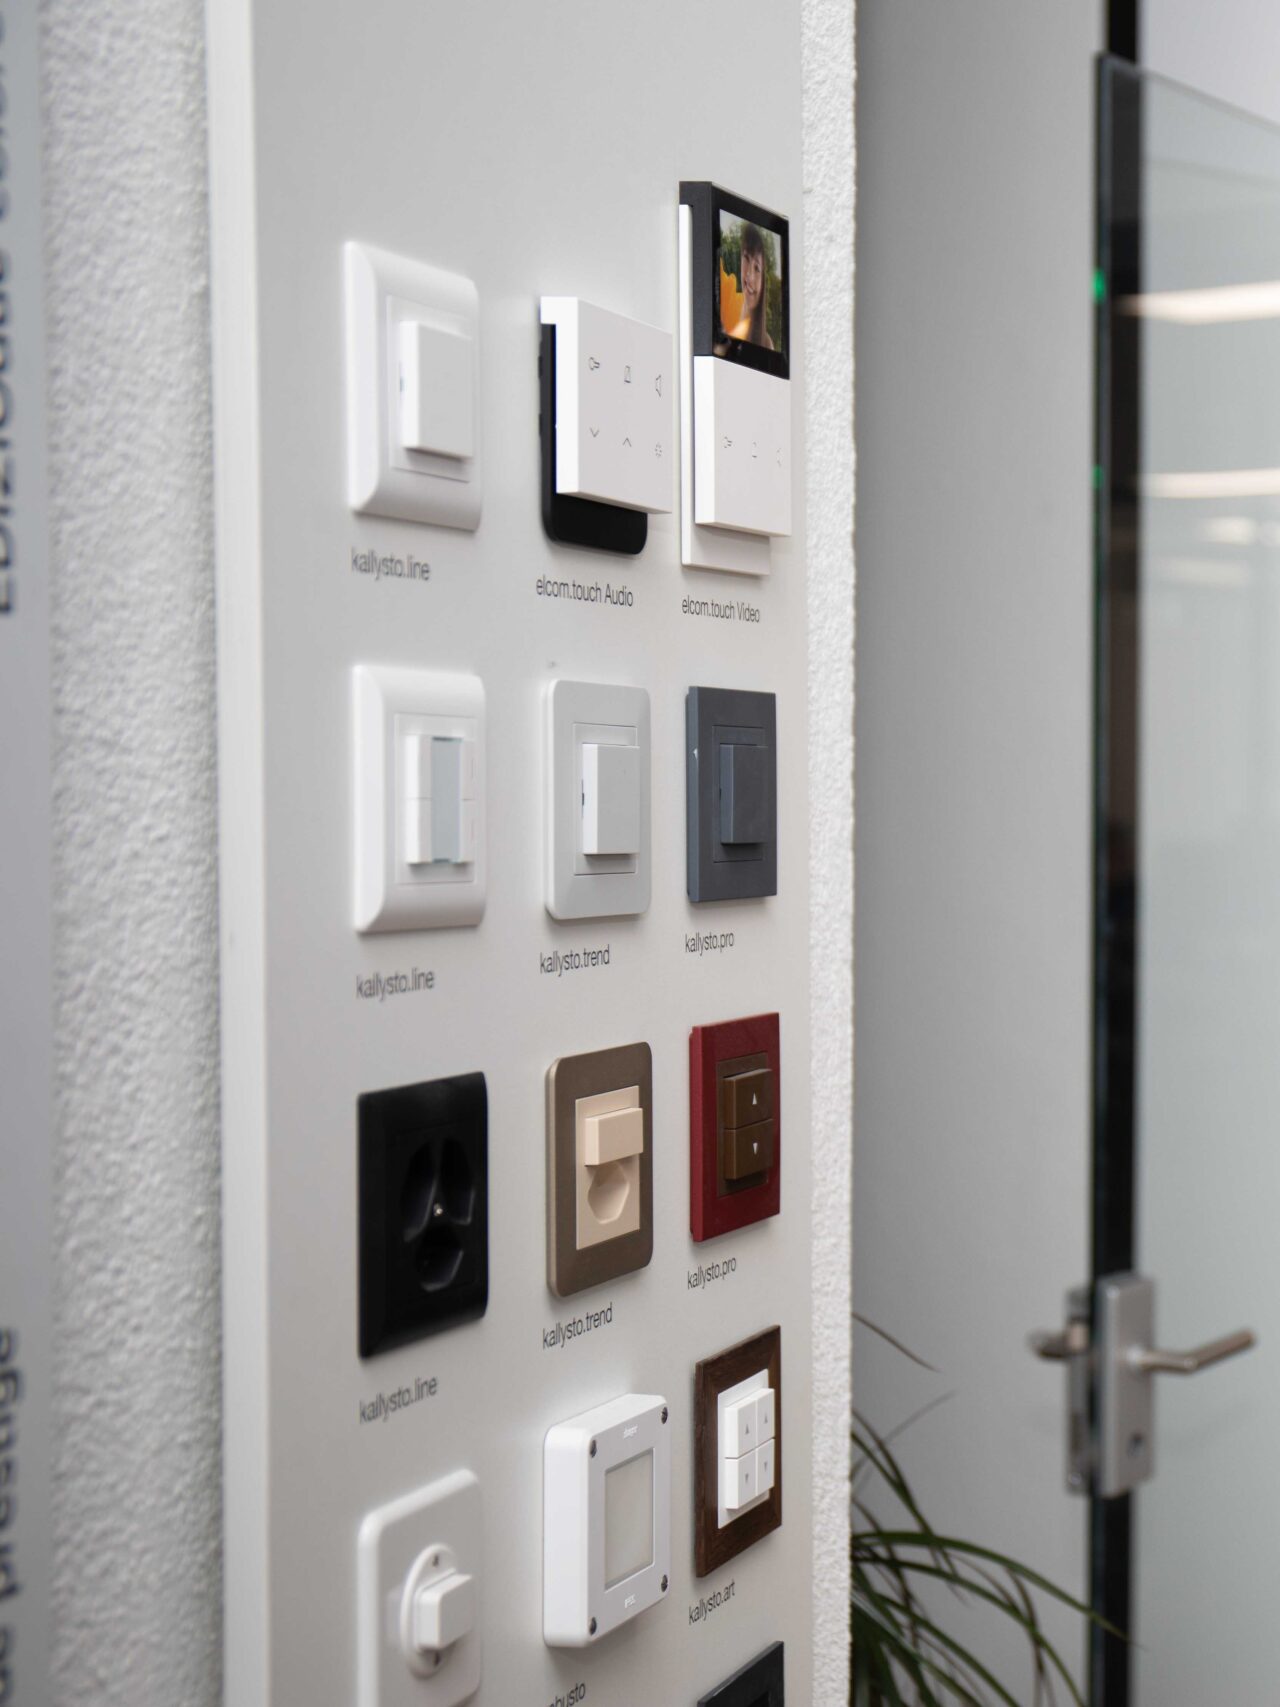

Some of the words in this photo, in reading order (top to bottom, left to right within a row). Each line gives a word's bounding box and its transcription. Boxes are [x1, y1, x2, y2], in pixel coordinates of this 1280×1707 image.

[352, 547, 431, 582] kallysto.line
[536, 574, 602, 604] elcom.touch
[604, 583, 634, 608] Audio
[682, 595, 735, 620] elcom.touch
[736, 602, 761, 624] Video
[540, 944, 611, 977] kallysto.trend
[685, 929, 735, 957] kallysto.pro
[356, 968, 436, 1003] kallysto.line
[687, 1255, 737, 1291] kallysto.pro
[543, 1302, 613, 1350] kallysto.trend
[359, 1374, 439, 1425] kallysto.line
[688, 1579, 736, 1626] kallysto.art
